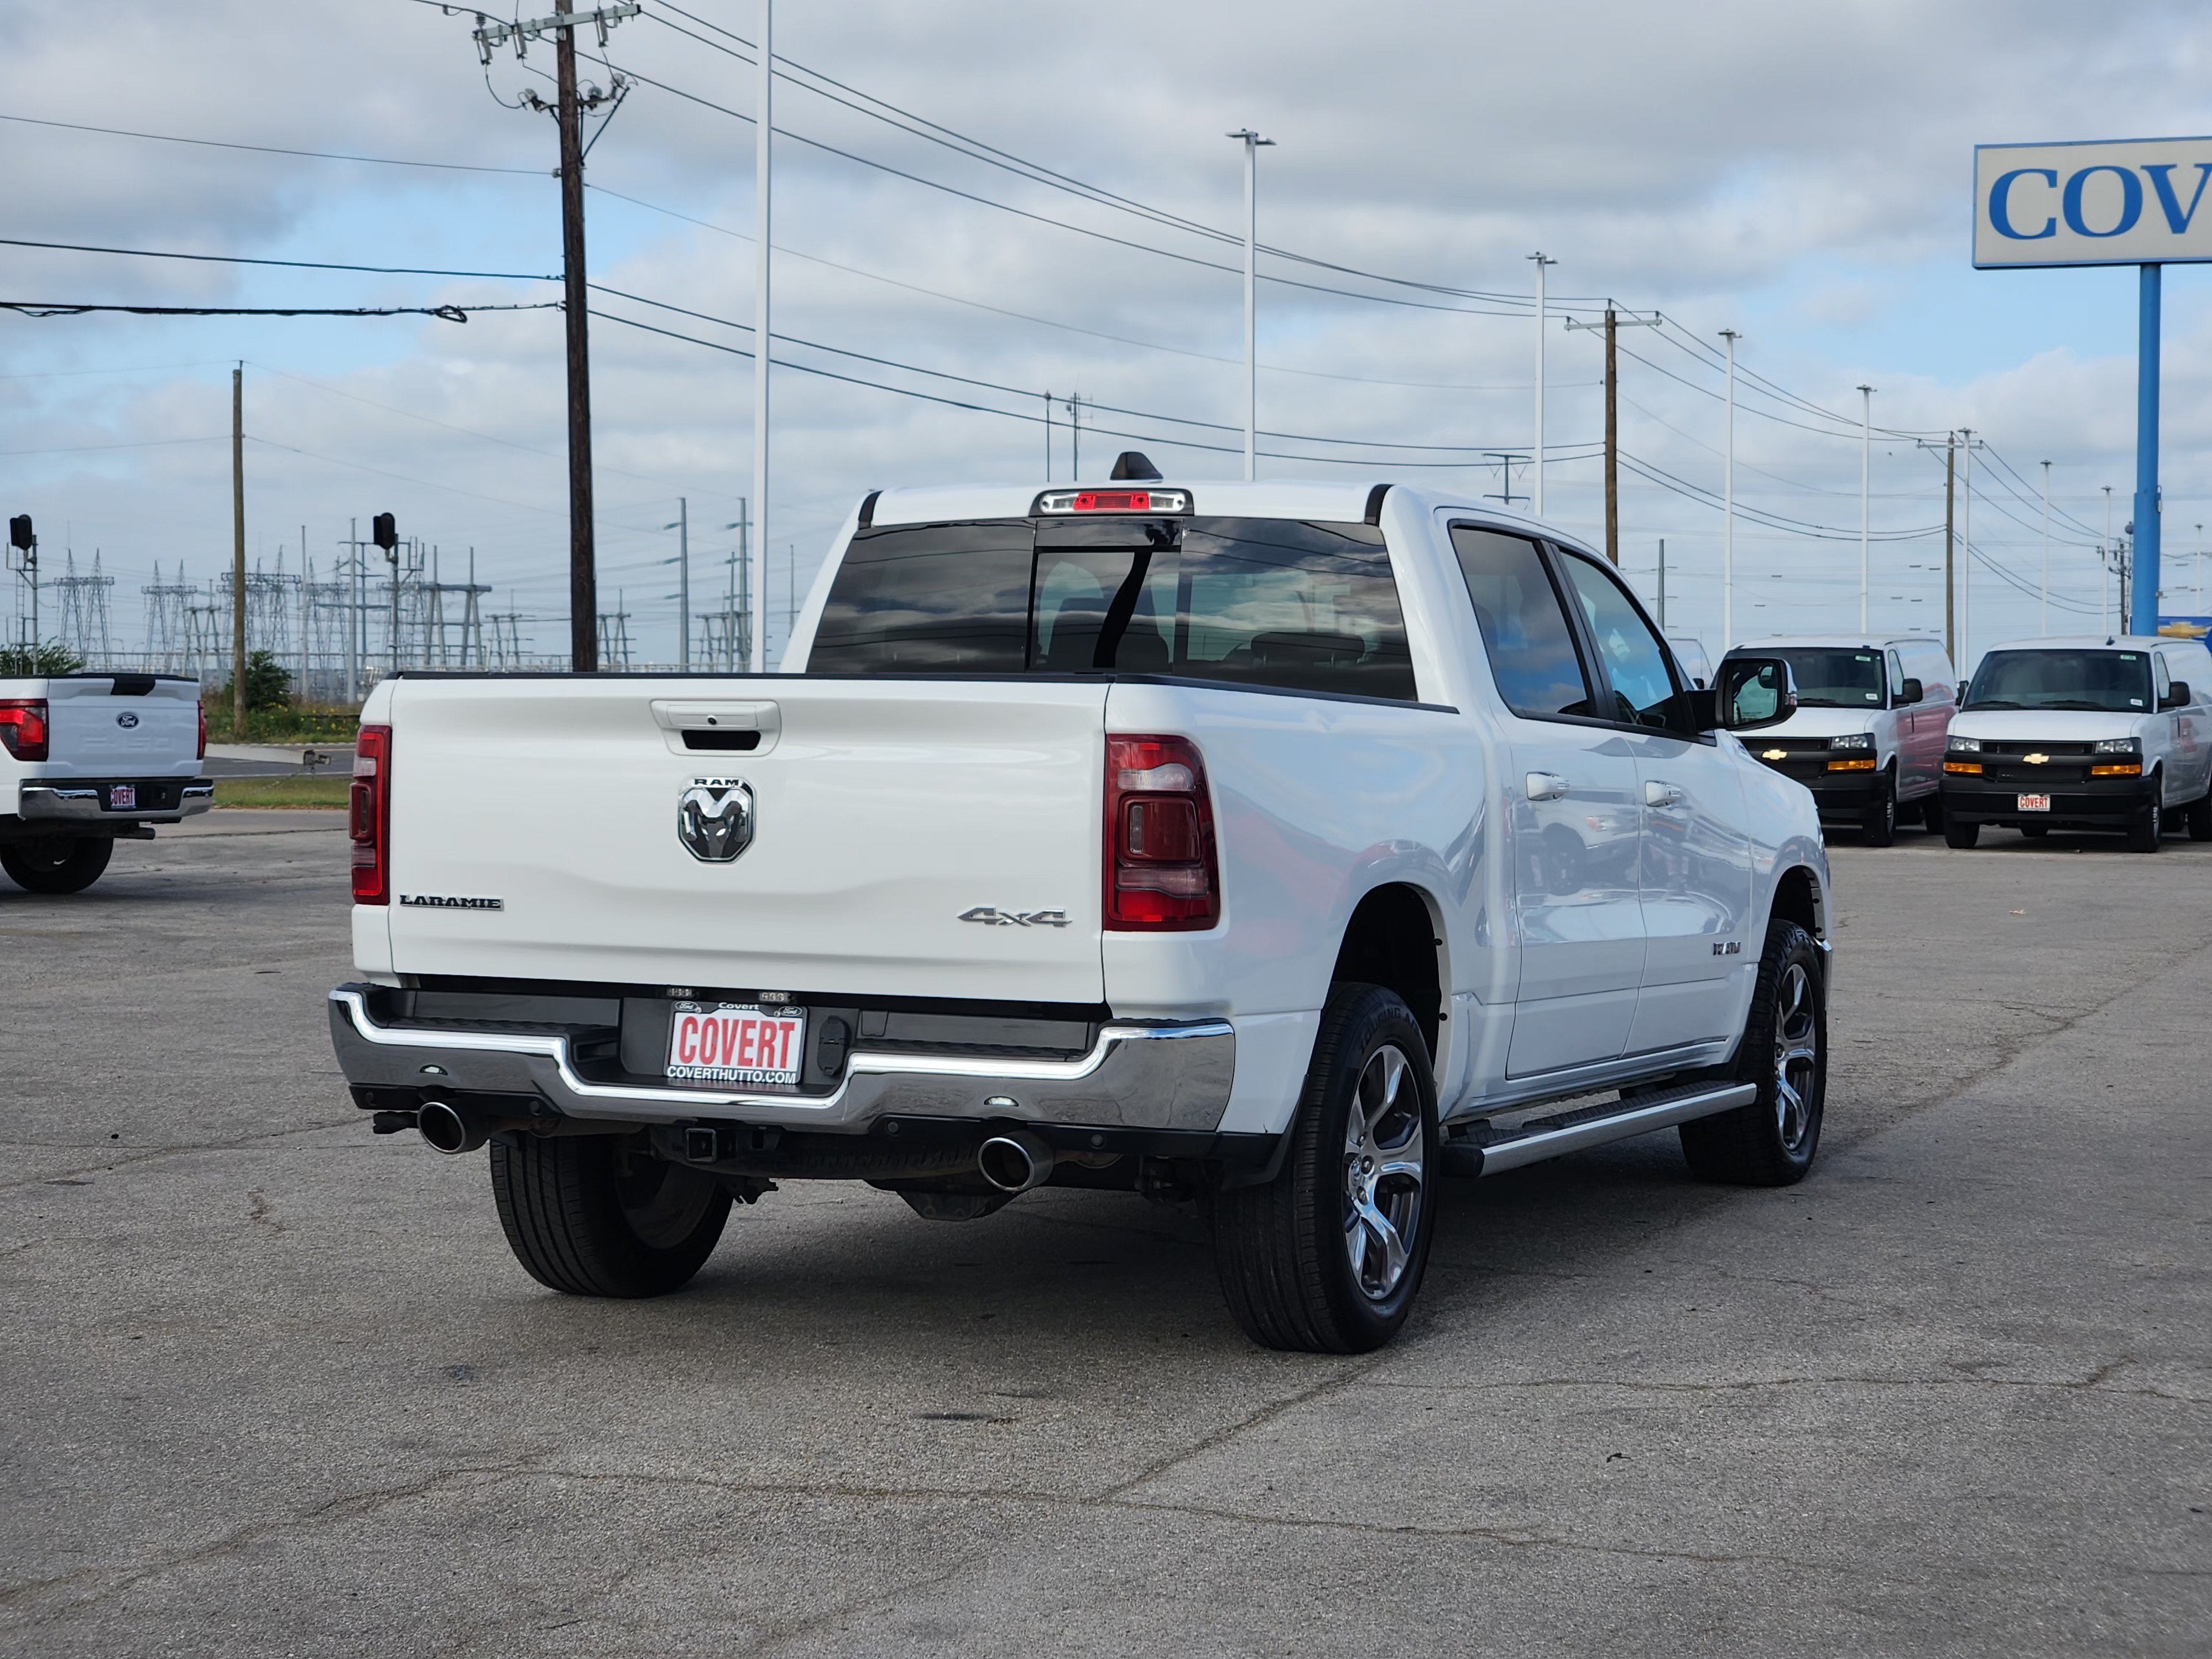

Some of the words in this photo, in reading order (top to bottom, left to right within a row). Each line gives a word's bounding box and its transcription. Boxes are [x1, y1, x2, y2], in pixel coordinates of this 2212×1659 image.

[2020, 797, 2048, 808] COVERT
[399, 894, 503, 910] LARAMIE
[1713, 941, 1741, 956] RAM
[718, 1001, 759, 1010] Covert
[679, 1016, 795, 1069] COVERT
[667, 1066, 796, 1084] COVERTHUTTO.COM
